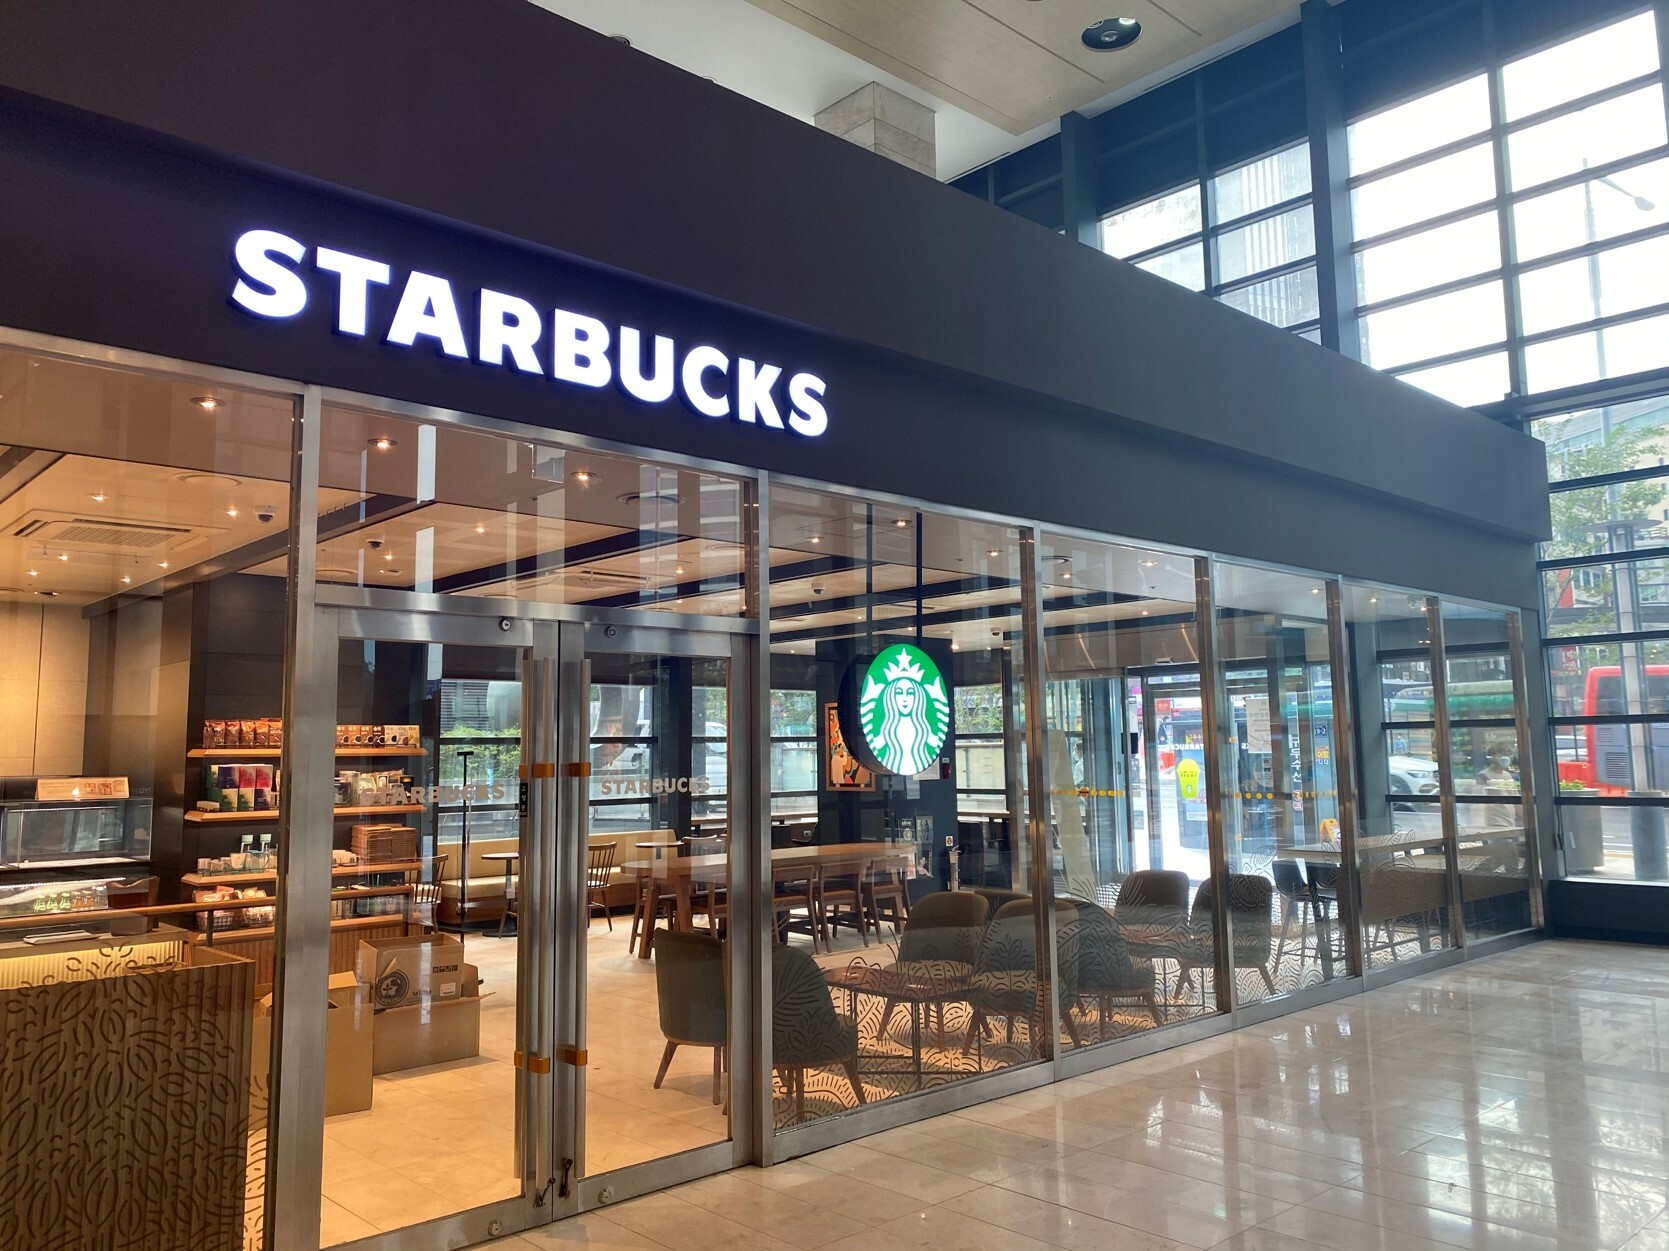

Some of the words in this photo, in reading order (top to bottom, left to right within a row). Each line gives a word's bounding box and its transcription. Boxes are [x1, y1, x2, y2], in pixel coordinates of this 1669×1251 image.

[230, 228, 829, 438] STARBUCKS
[360, 783, 505, 806] STARBUCKS
[601, 776, 710, 795] STARBUCKS
